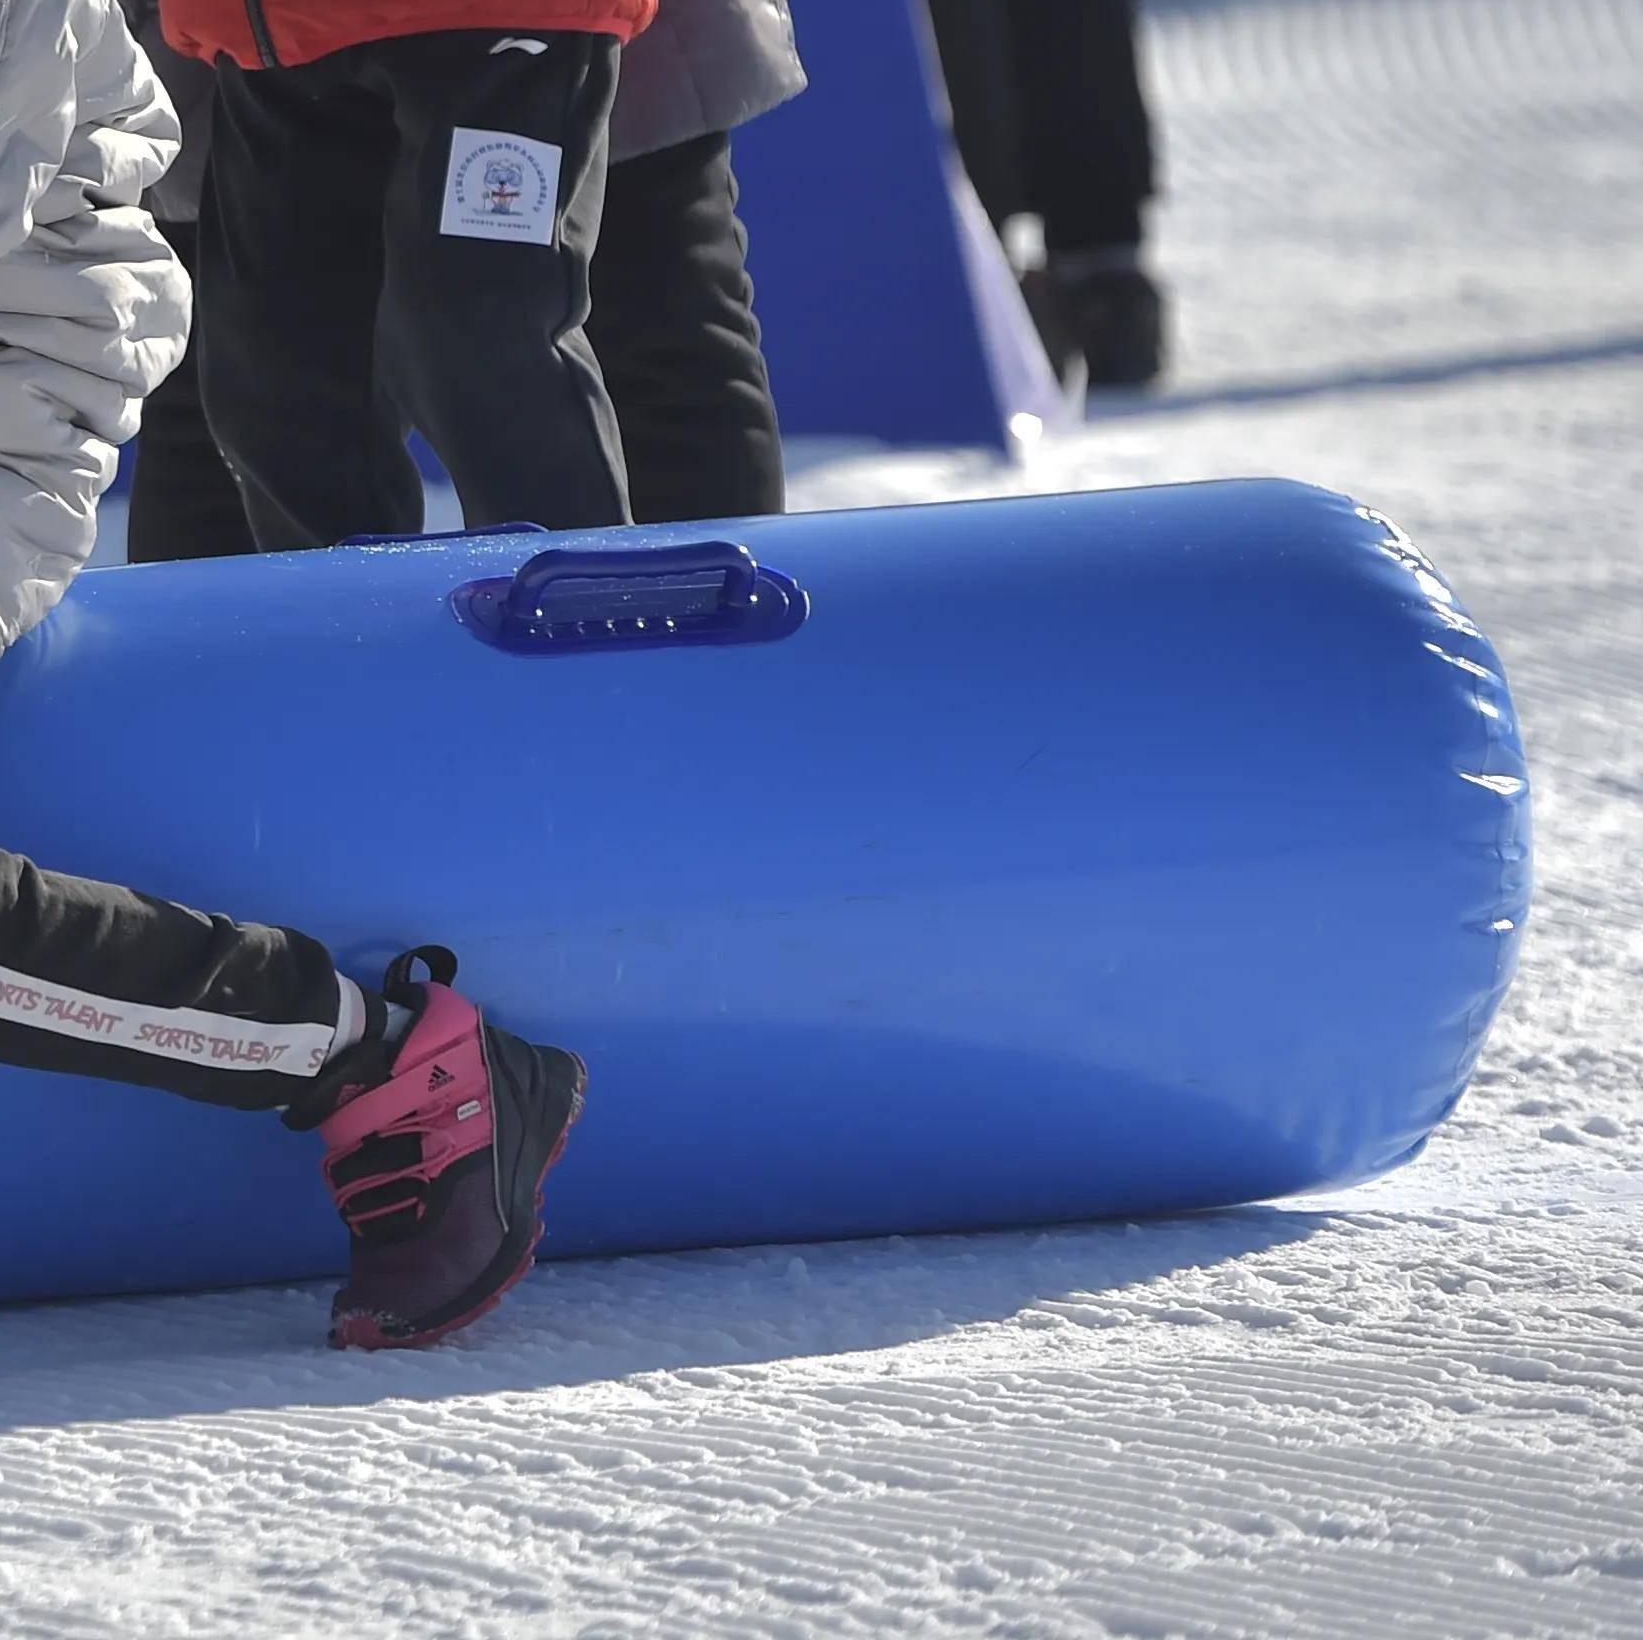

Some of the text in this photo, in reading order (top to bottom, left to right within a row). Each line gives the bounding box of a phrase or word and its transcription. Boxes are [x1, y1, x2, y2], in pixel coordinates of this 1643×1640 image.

[44, 995, 123, 1034] TALENT
[134, 1023, 206, 1054] SPORTS
[208, 1036, 291, 1064] TALENT
